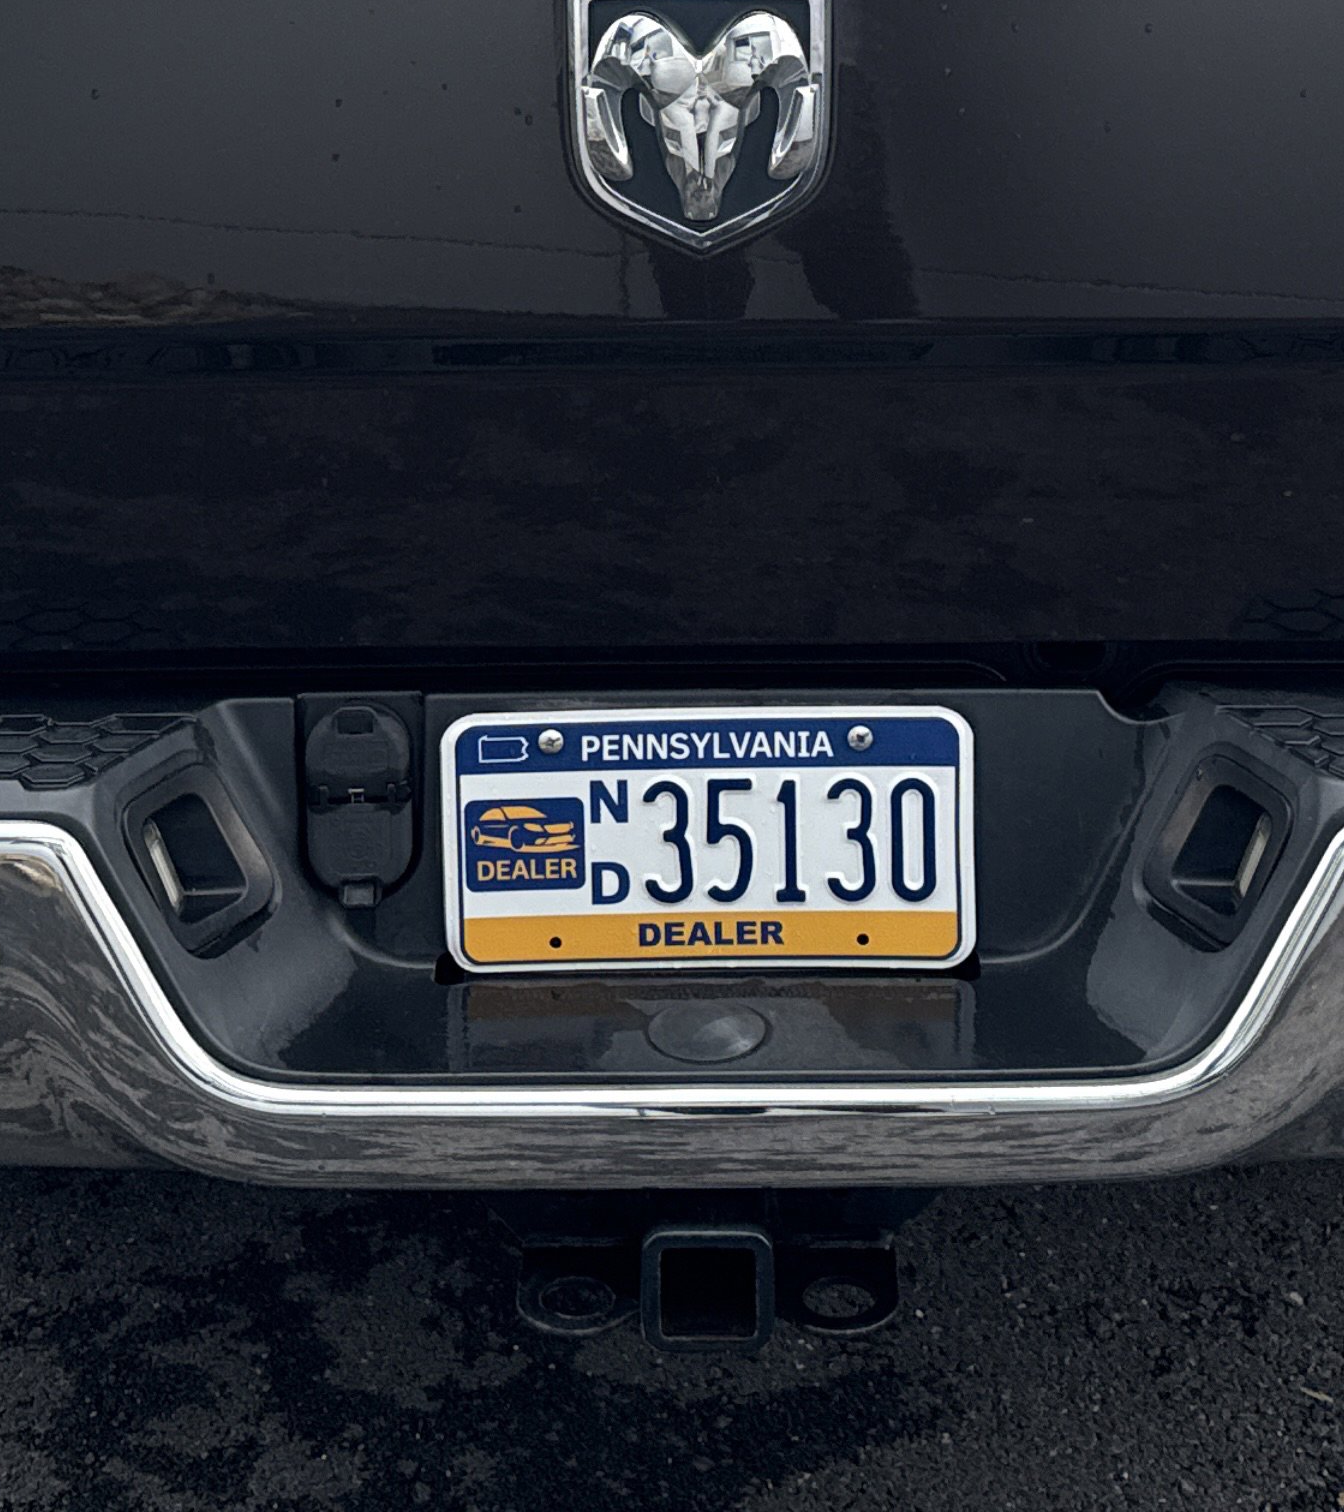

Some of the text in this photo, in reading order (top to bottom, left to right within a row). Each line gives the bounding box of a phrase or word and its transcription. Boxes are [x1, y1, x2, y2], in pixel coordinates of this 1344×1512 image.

[581, 731, 834, 762] PENNSYLVANIA
[642, 778, 937, 903] 35130
[476, 858, 577, 882] DEALER
[638, 920, 785, 947] DEALER
